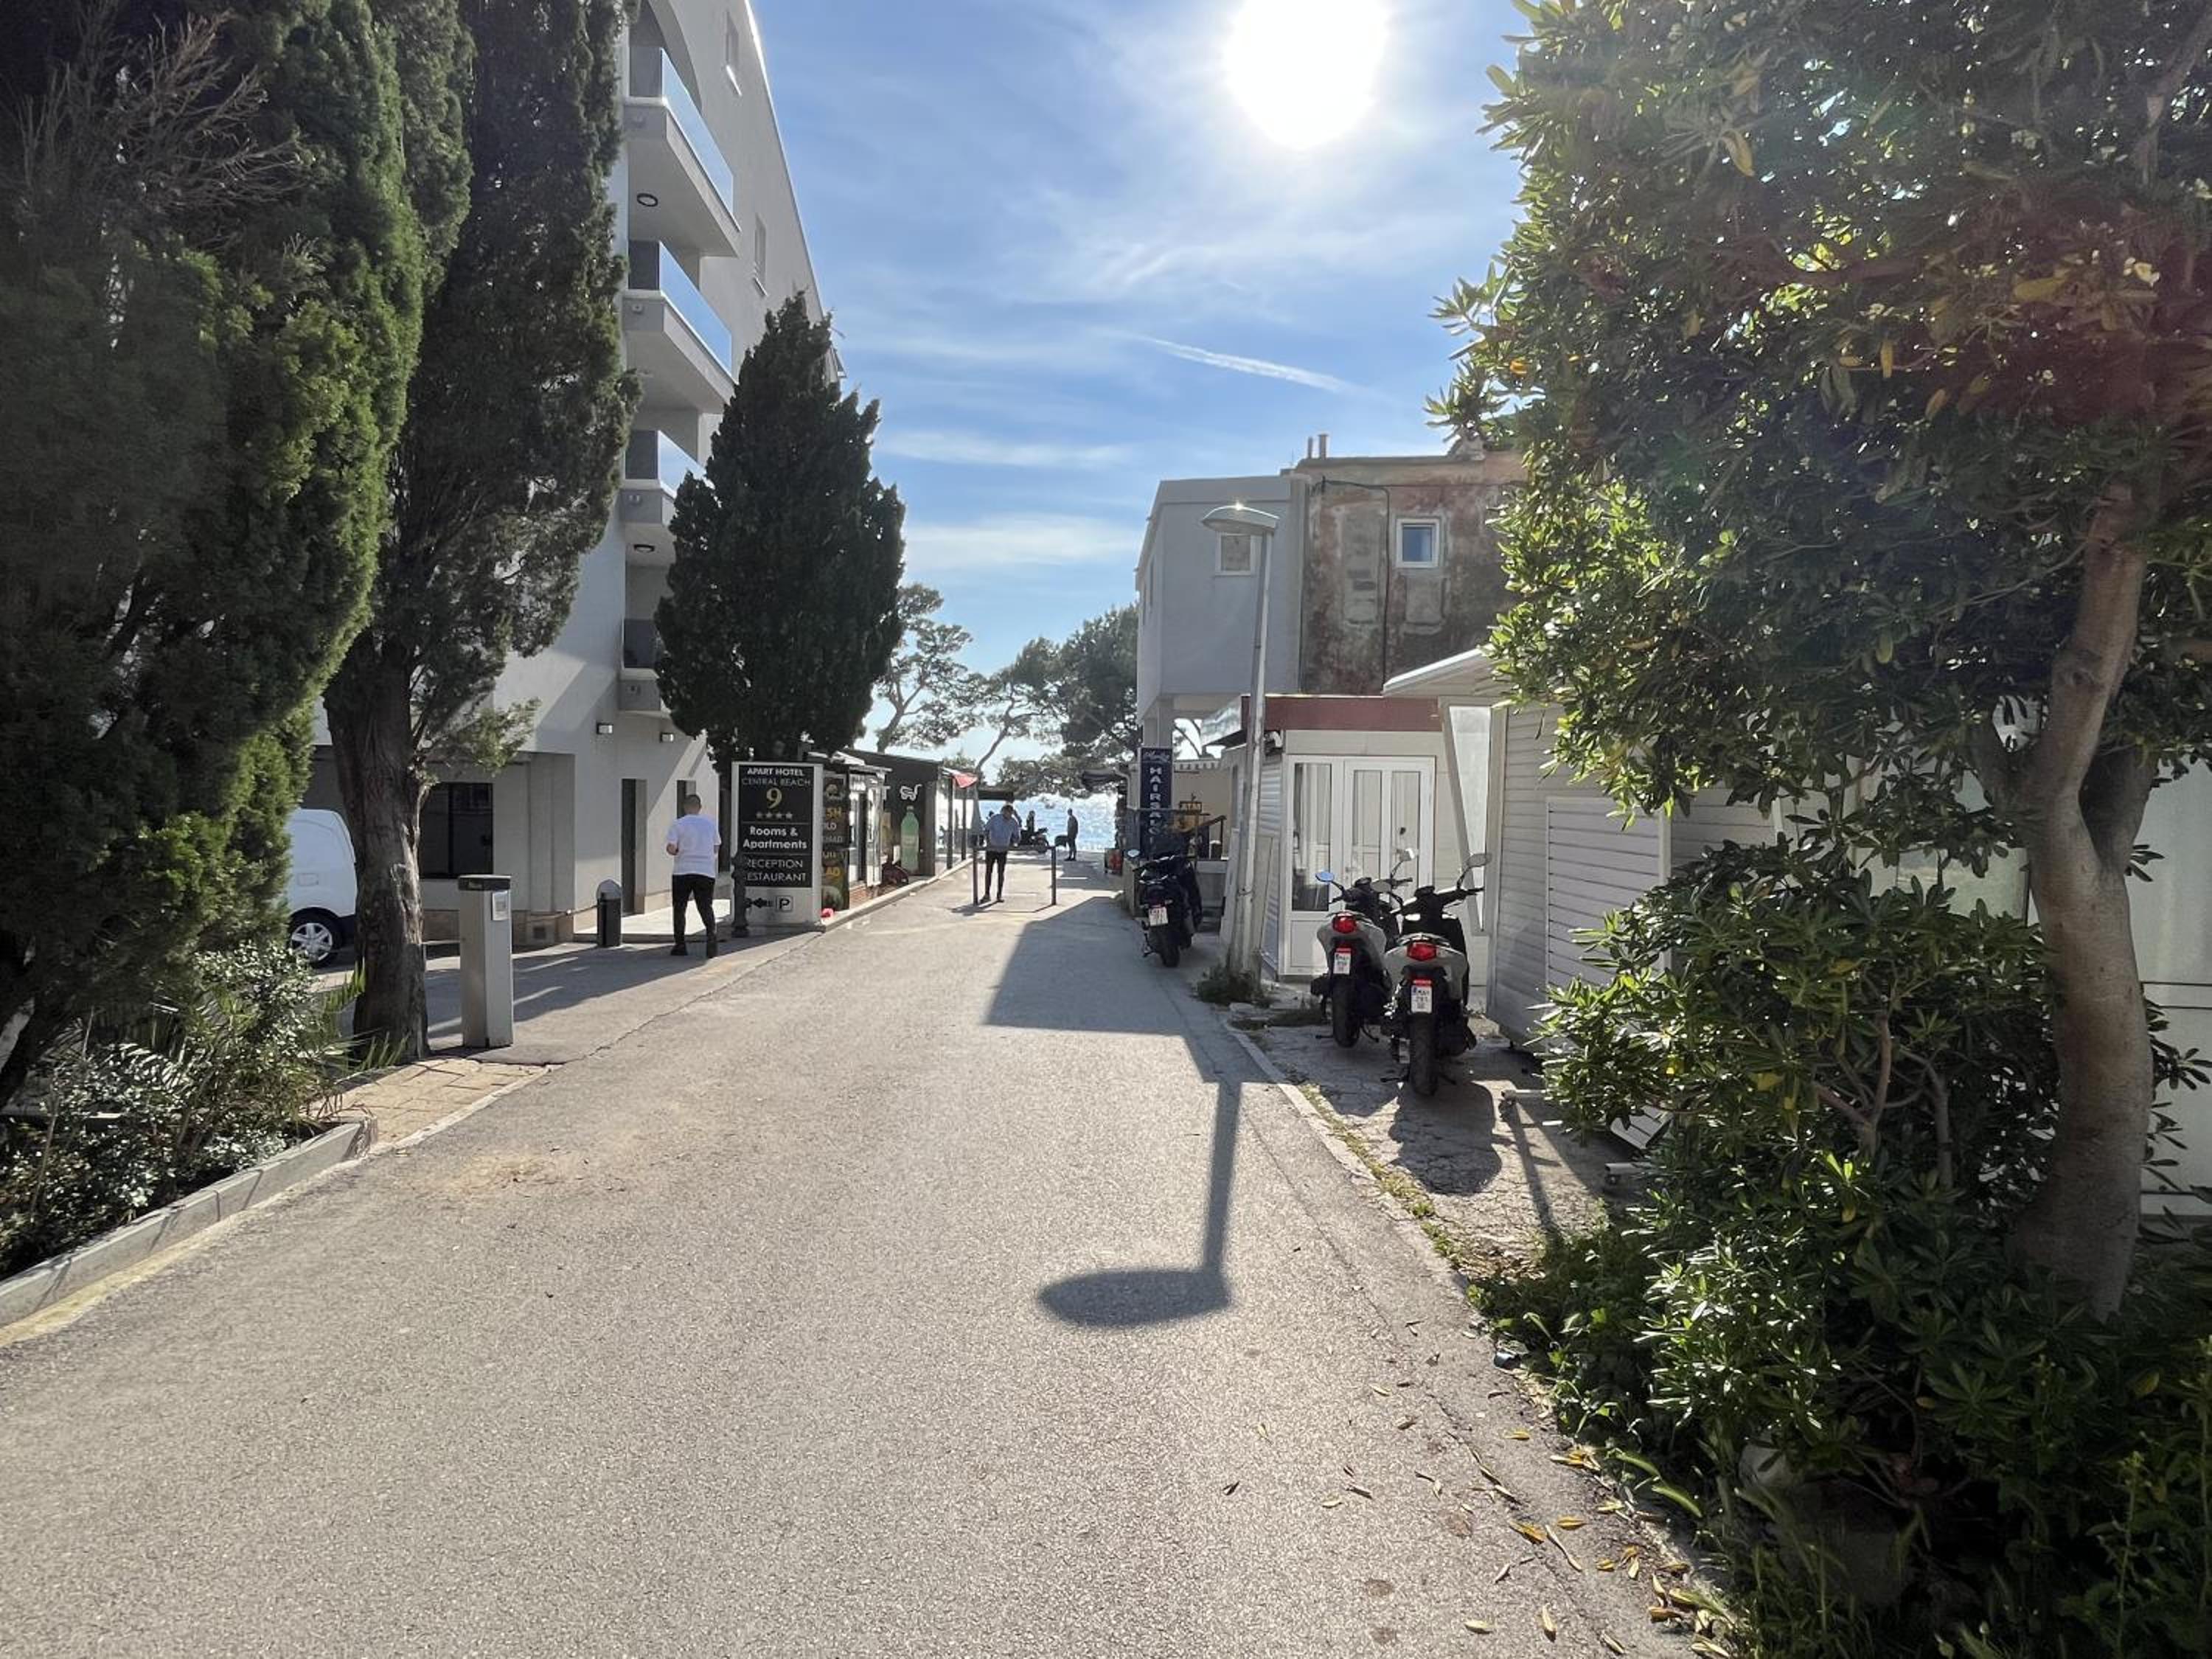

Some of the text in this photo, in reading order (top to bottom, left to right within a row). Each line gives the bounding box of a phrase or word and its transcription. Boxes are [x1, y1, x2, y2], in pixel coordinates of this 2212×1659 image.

[775, 768, 804, 776] HOTEL
[780, 778, 811, 787] BEACH
[766, 787, 782, 809] 9
[750, 826, 799, 836] Rooms &
[742, 838, 807, 850] Apartments
[744, 872, 807, 882] ESTAURANT
